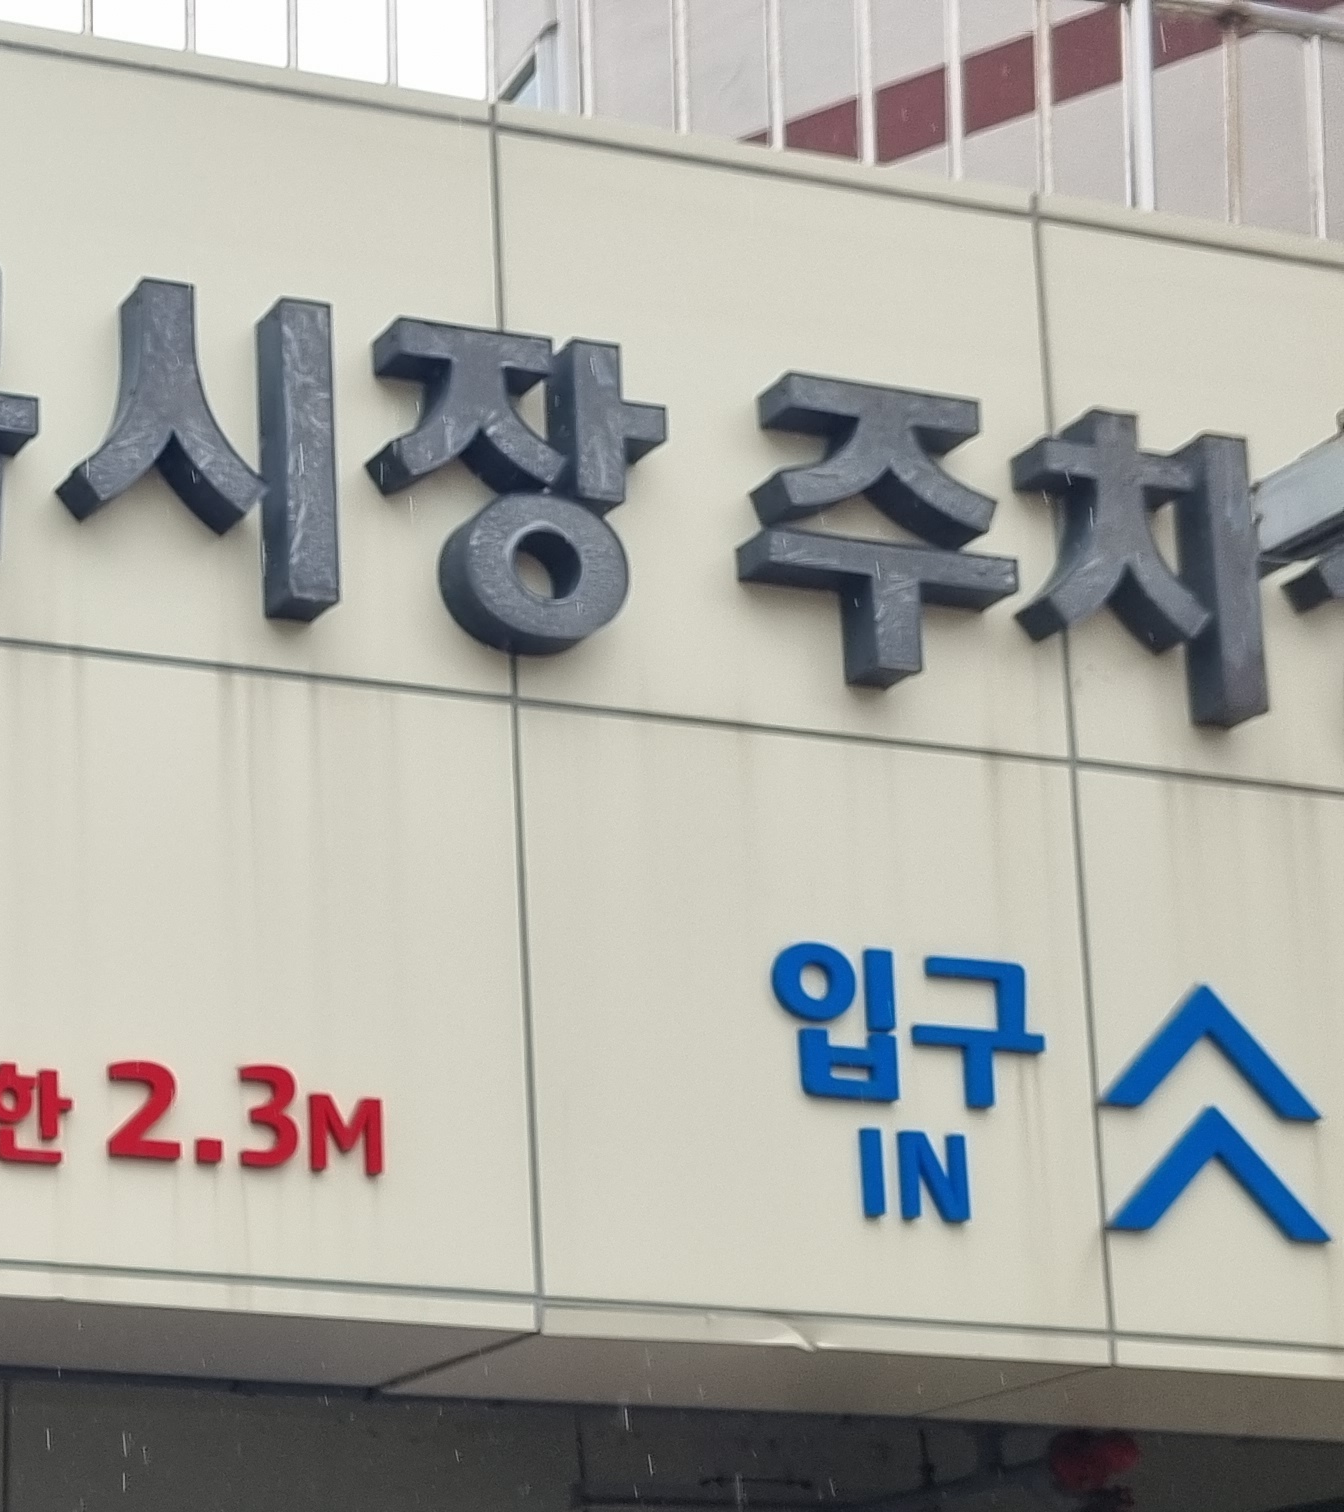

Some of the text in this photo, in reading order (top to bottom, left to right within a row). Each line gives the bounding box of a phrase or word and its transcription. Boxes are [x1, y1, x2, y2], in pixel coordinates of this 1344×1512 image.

[737, 370, 1344, 729] 주차
[772, 942, 1045, 1109] 입구
[106, 1060, 384, 1177] 2.3M
[859, 1127, 970, 1224] IN
